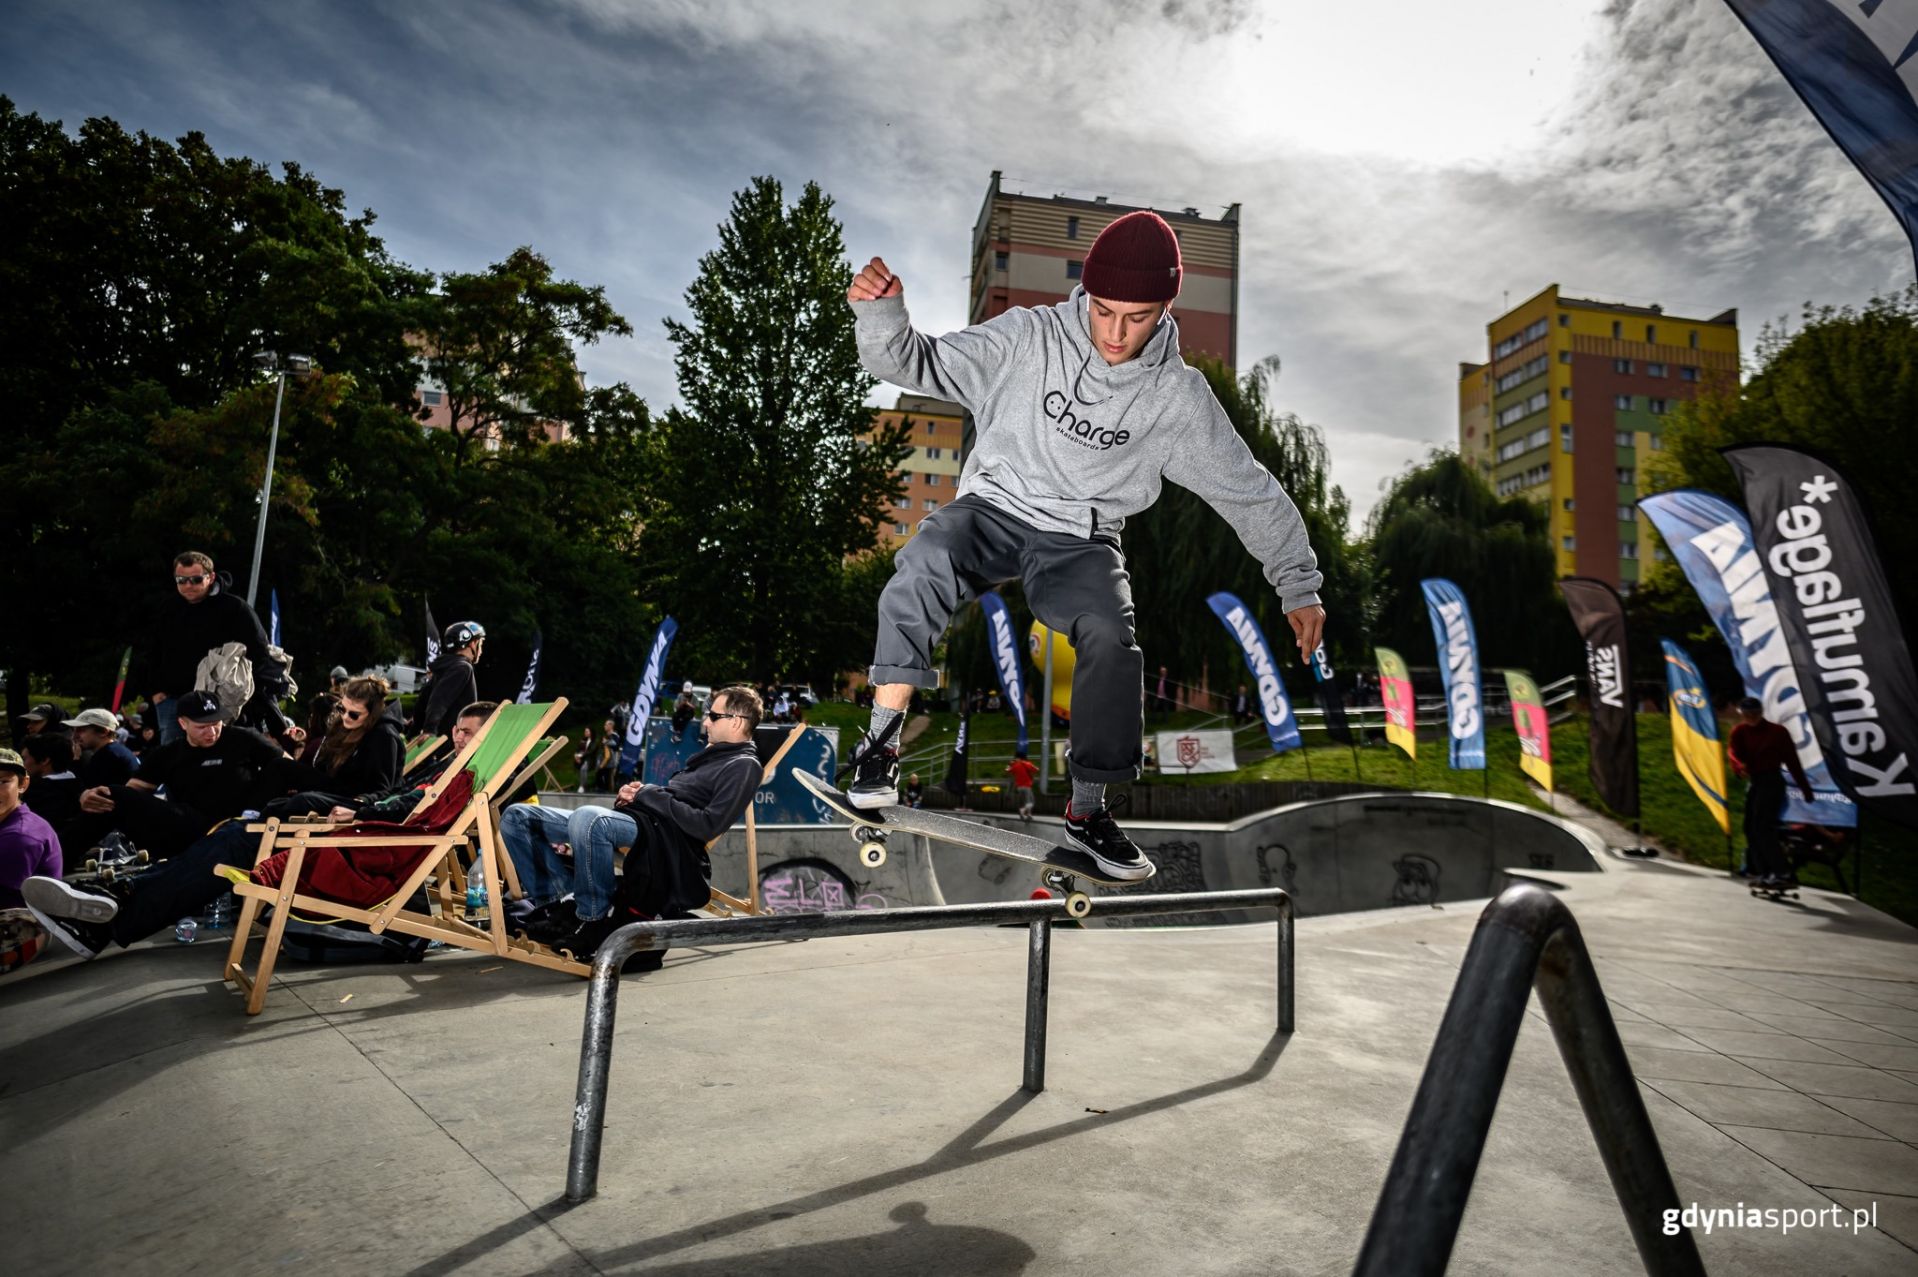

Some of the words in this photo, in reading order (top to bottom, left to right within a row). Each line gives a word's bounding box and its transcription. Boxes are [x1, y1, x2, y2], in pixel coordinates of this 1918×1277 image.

[1043, 390, 1130, 450] Charge
[1056, 426, 1100, 451] skateboards
[626, 631, 667, 746] GDYNIA
